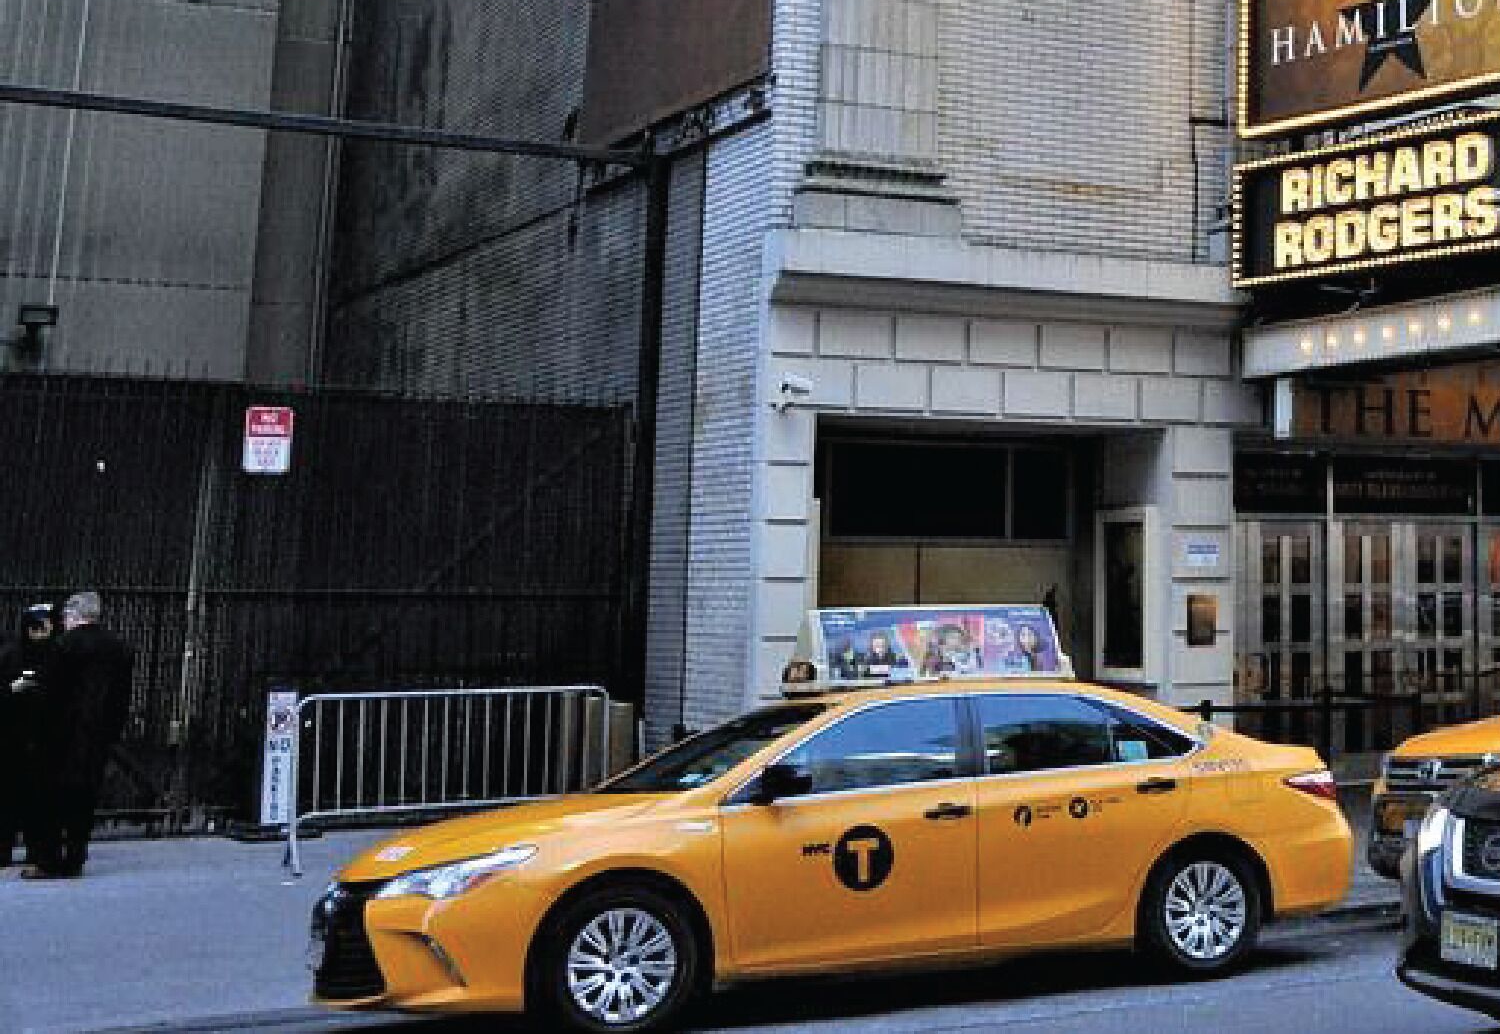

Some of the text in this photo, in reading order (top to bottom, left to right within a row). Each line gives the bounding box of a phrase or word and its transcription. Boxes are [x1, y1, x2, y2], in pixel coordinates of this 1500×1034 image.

[1281, 132, 1495, 215] RICHARD
[1317, 387, 1434, 437] THE
[846, 838, 880, 883] T
